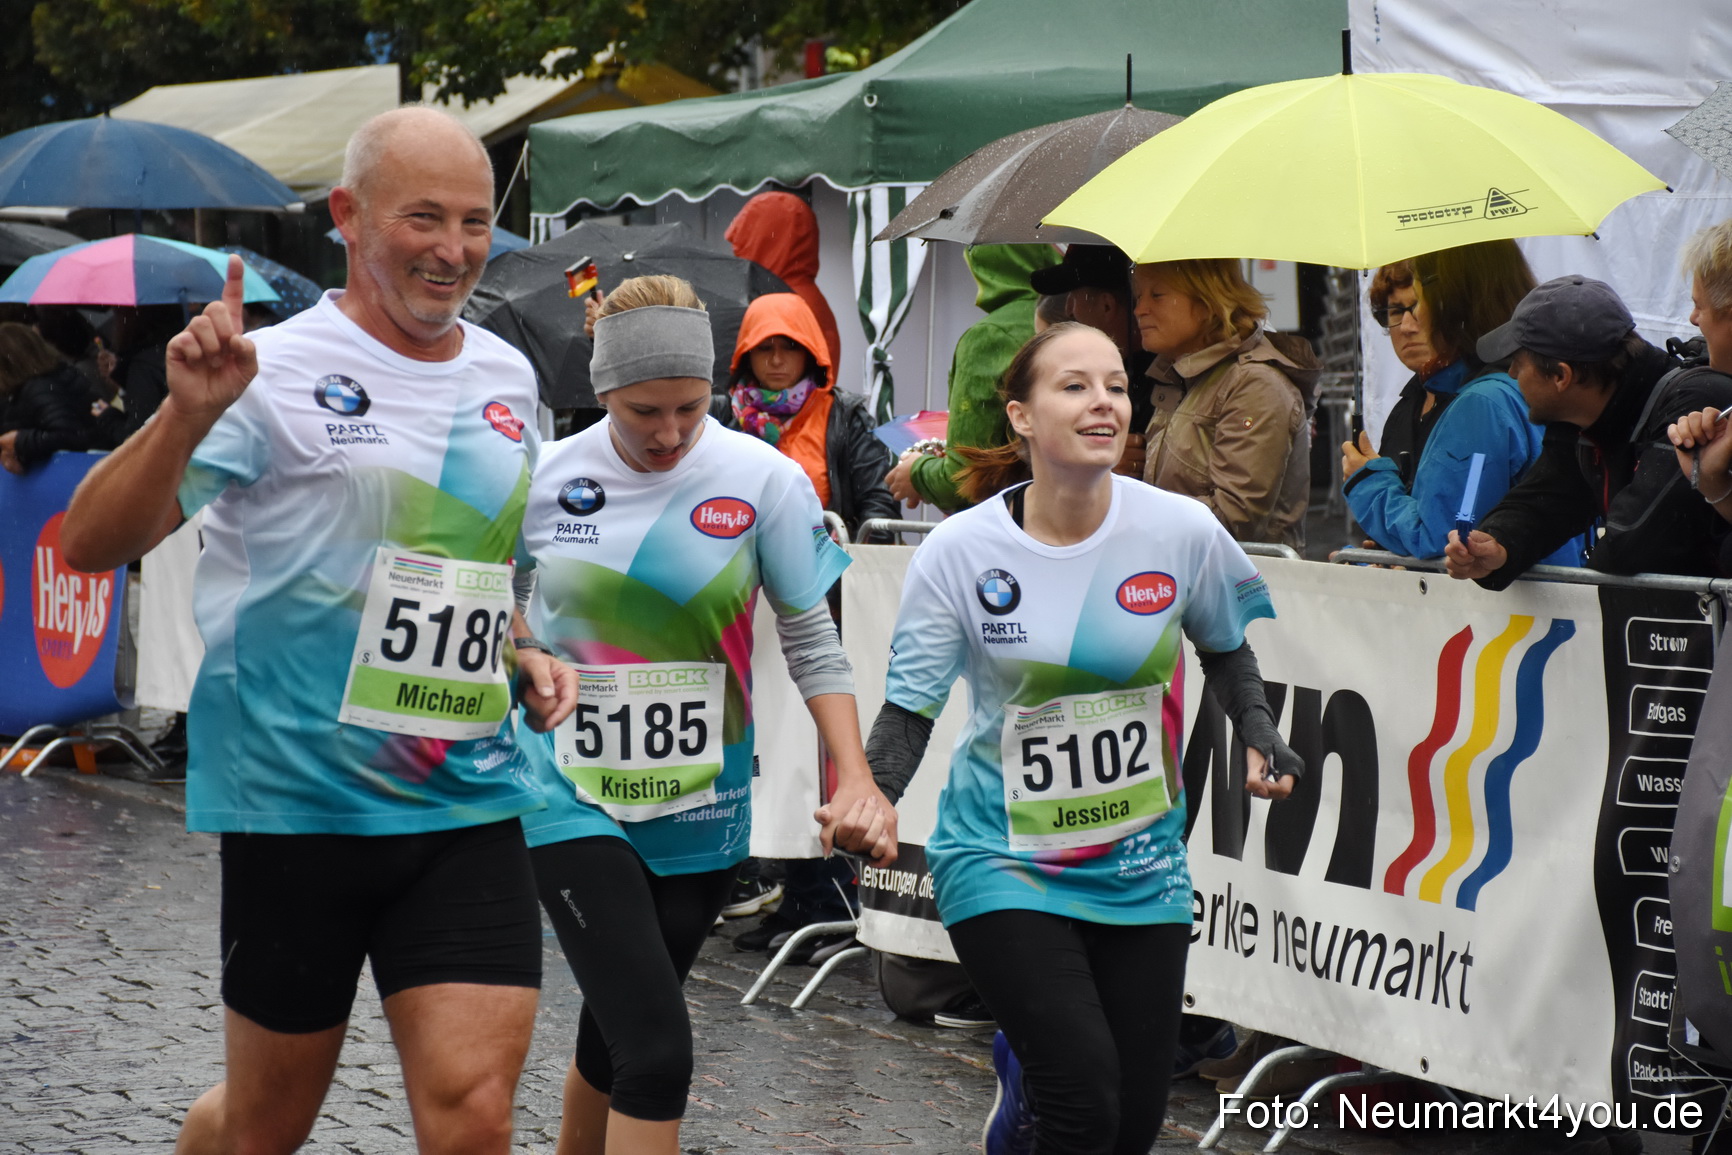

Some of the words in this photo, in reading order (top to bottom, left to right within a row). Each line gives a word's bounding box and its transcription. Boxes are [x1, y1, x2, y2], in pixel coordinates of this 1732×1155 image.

[1397, 205, 1473, 226] prototyp
[1490, 206, 1519, 217] PWZ
[325, 424, 386, 436] PARTL
[330, 437, 389, 446] Neumarkt
[700, 507, 750, 529] Hervis
[557, 523, 600, 535] PARTL
[552, 535, 599, 545] Neumarkt
[388, 572, 444, 589] NeuerMarkt
[456, 568, 508, 593] BOC
[36, 545, 109, 655] Hervis
[1125, 583, 1174, 604] Hervis
[381, 597, 507, 674] 5186
[982, 623, 1027, 635] PARTL
[983, 635, 1028, 645] Neumarkt
[362, 652, 370, 664] S
[578, 683, 619, 692] uerMarkt
[628, 668, 709, 688] BOCK
[396, 682, 485, 716] Michael
[1074, 692, 1148, 719] BOCK
[575, 700, 708, 761] 5185
[1014, 714, 1066, 732] NeuerMarkt
[563, 754, 570, 765] S
[1022, 720, 1150, 792] 5102
[601, 775, 681, 800] Kristina
[715, 786, 750, 801] arkter
[1637, 774, 1684, 793] Wass
[1012, 790, 1019, 800] S
[673, 803, 739, 823] Stadtlauf
[1053, 800, 1130, 828] Jessica
[1123, 833, 1158, 855] 17.
[1189, 882, 1259, 959] erke
[1273, 909, 1473, 1014] neumarkt
[1639, 987, 1673, 1011] Stadtl
